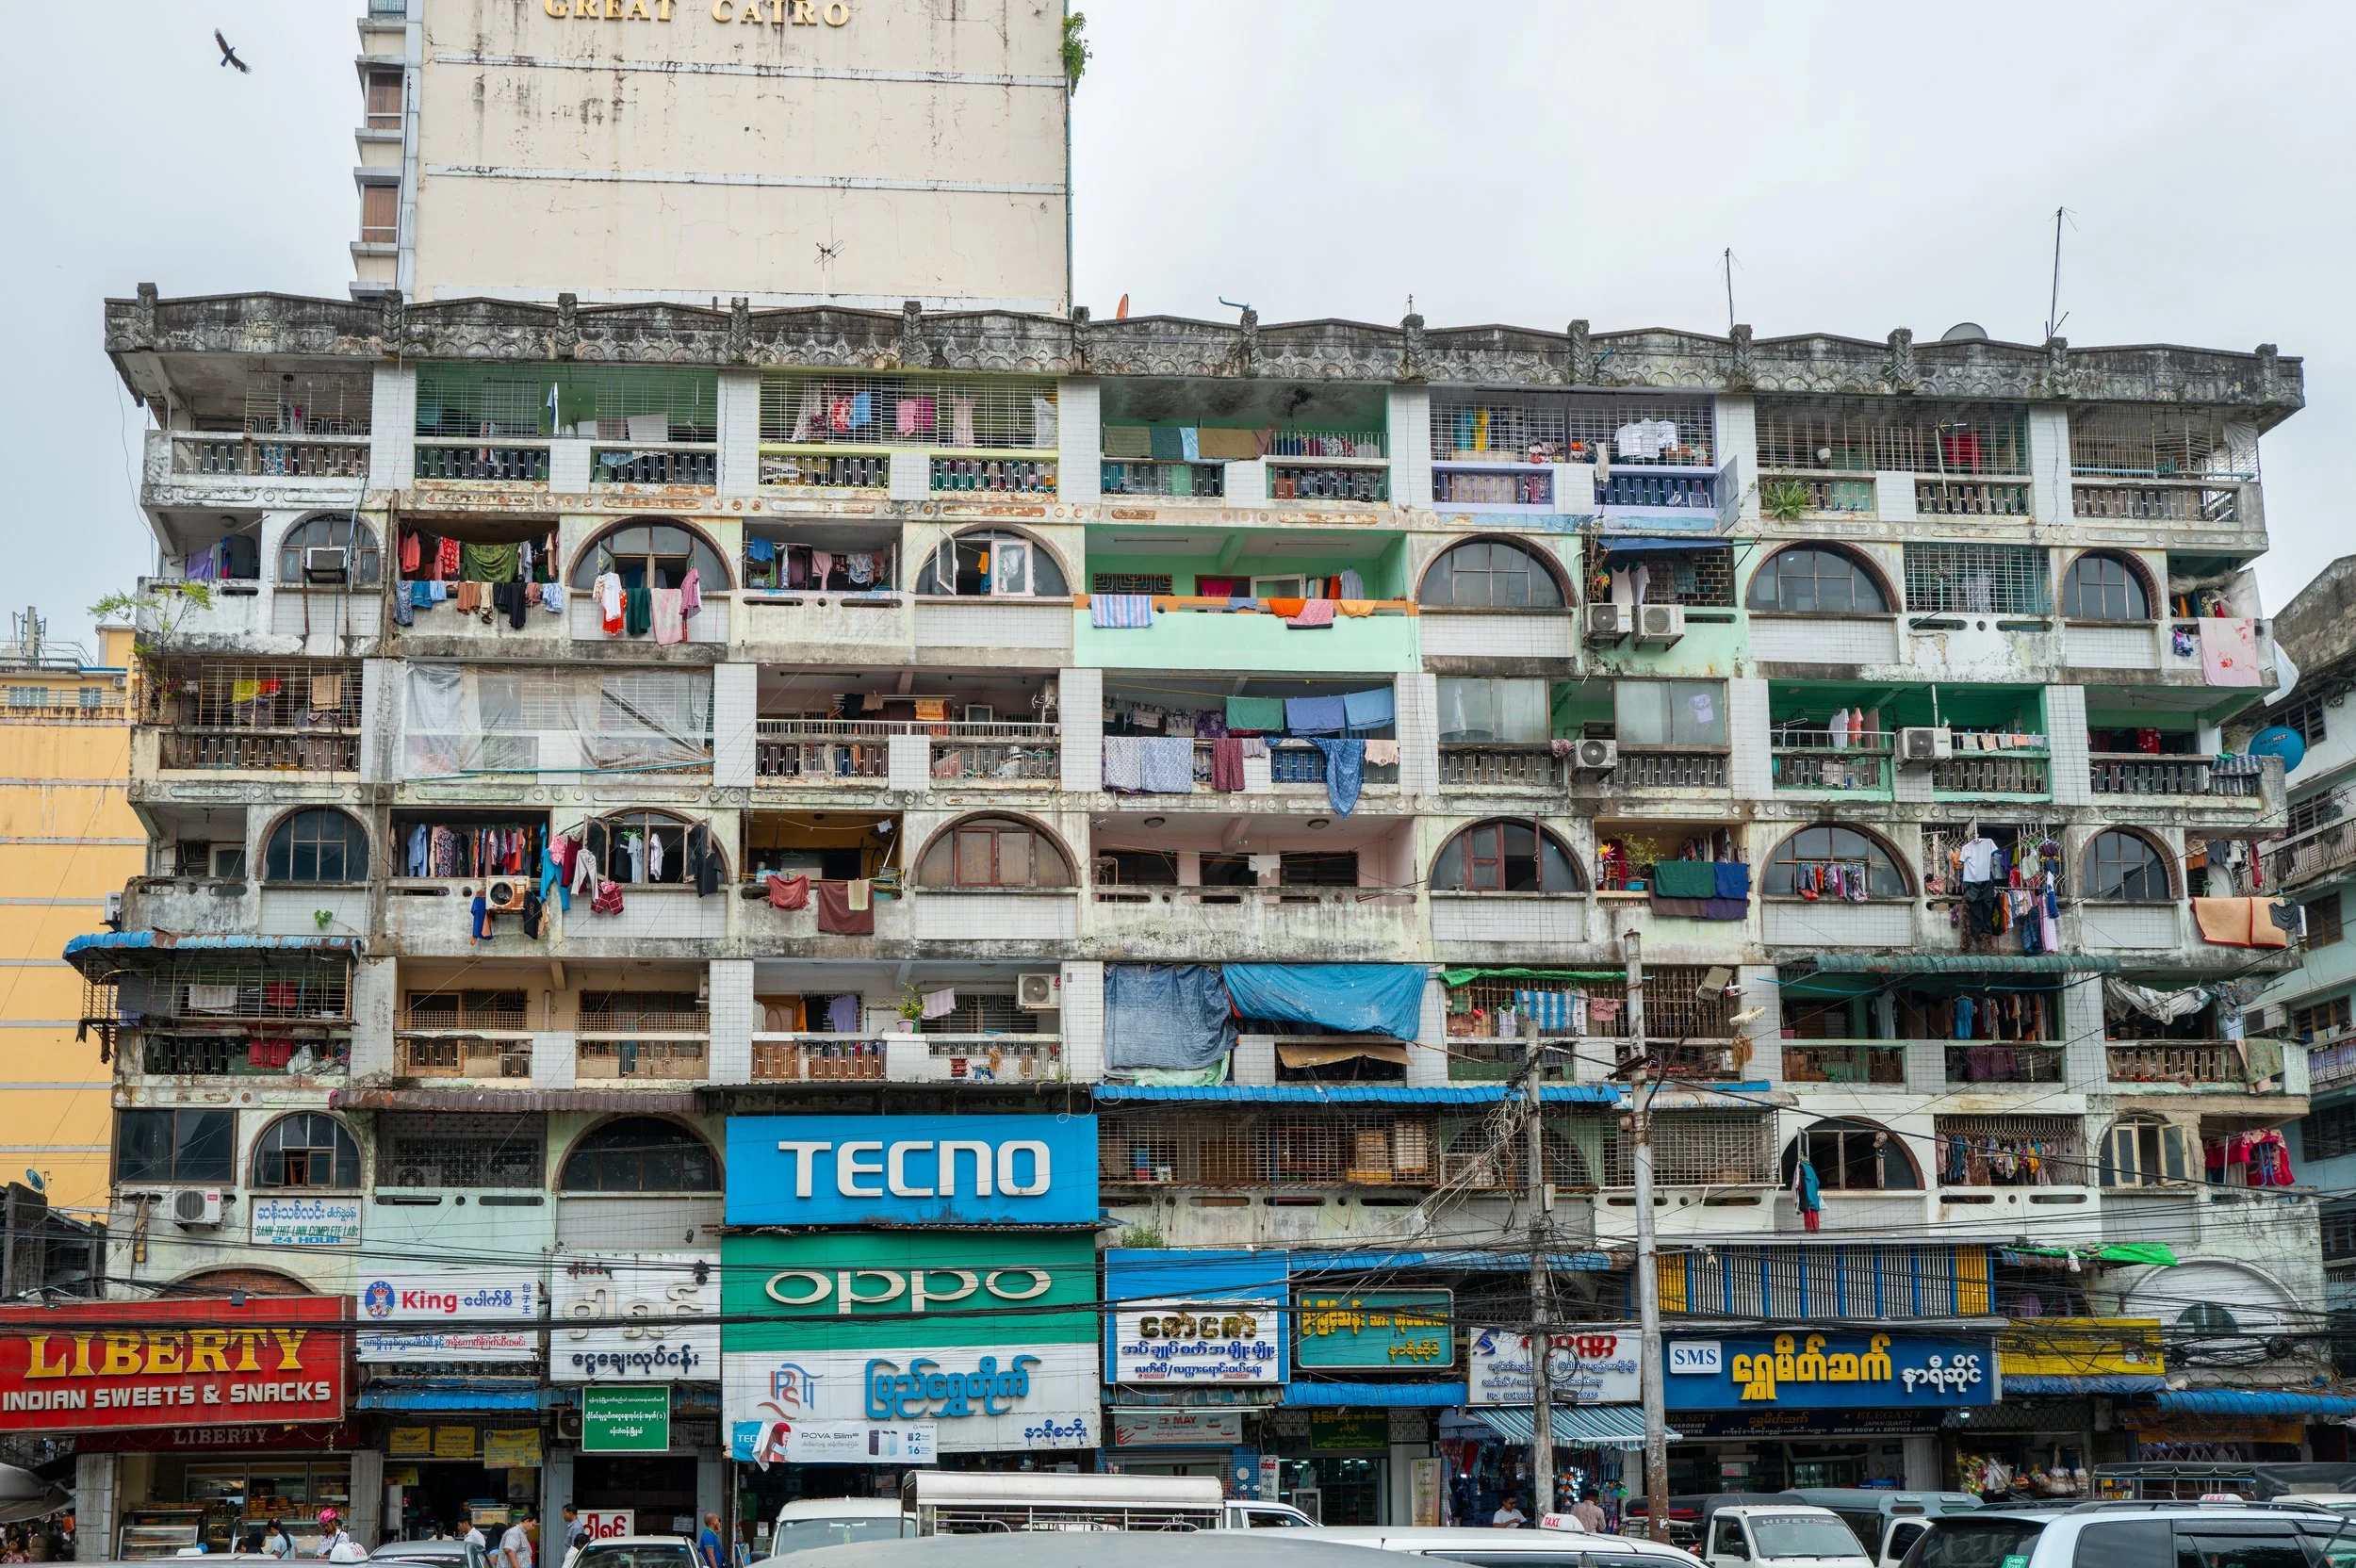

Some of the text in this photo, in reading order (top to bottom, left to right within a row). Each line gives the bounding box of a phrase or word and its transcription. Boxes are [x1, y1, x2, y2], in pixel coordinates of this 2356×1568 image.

[544, 0, 849, 27] GREAT CAIRO
[778, 1140, 1051, 1198] TECNO
[255, 1226, 272, 1236] SANN
[275, 1226, 290, 1236] THIT
[292, 1226, 307, 1236] LINN
[308, 1226, 342, 1236] COMPLETE
[402, 1290, 458, 1314] King
[522, 1282, 532, 1315] 包子王
[25, 1329, 311, 1378] LIBERTY
[1675, 1348, 1717, 1365] SMS
[1732, 1333, 1982, 1400] ရွှေမိတ်ဆက် နာရီဆိုင်
[3, 1381, 331, 1412] INDIAN SWEETS & SNACKS
[1856, 1411, 1923, 1419] ELEGANT
[172, 1429, 270, 1446] LIBERTY
[914, 1432, 921, 1442] 2
[913, 1446, 920, 1455] 6
[1545, 1517, 1561, 1527] TAXI
